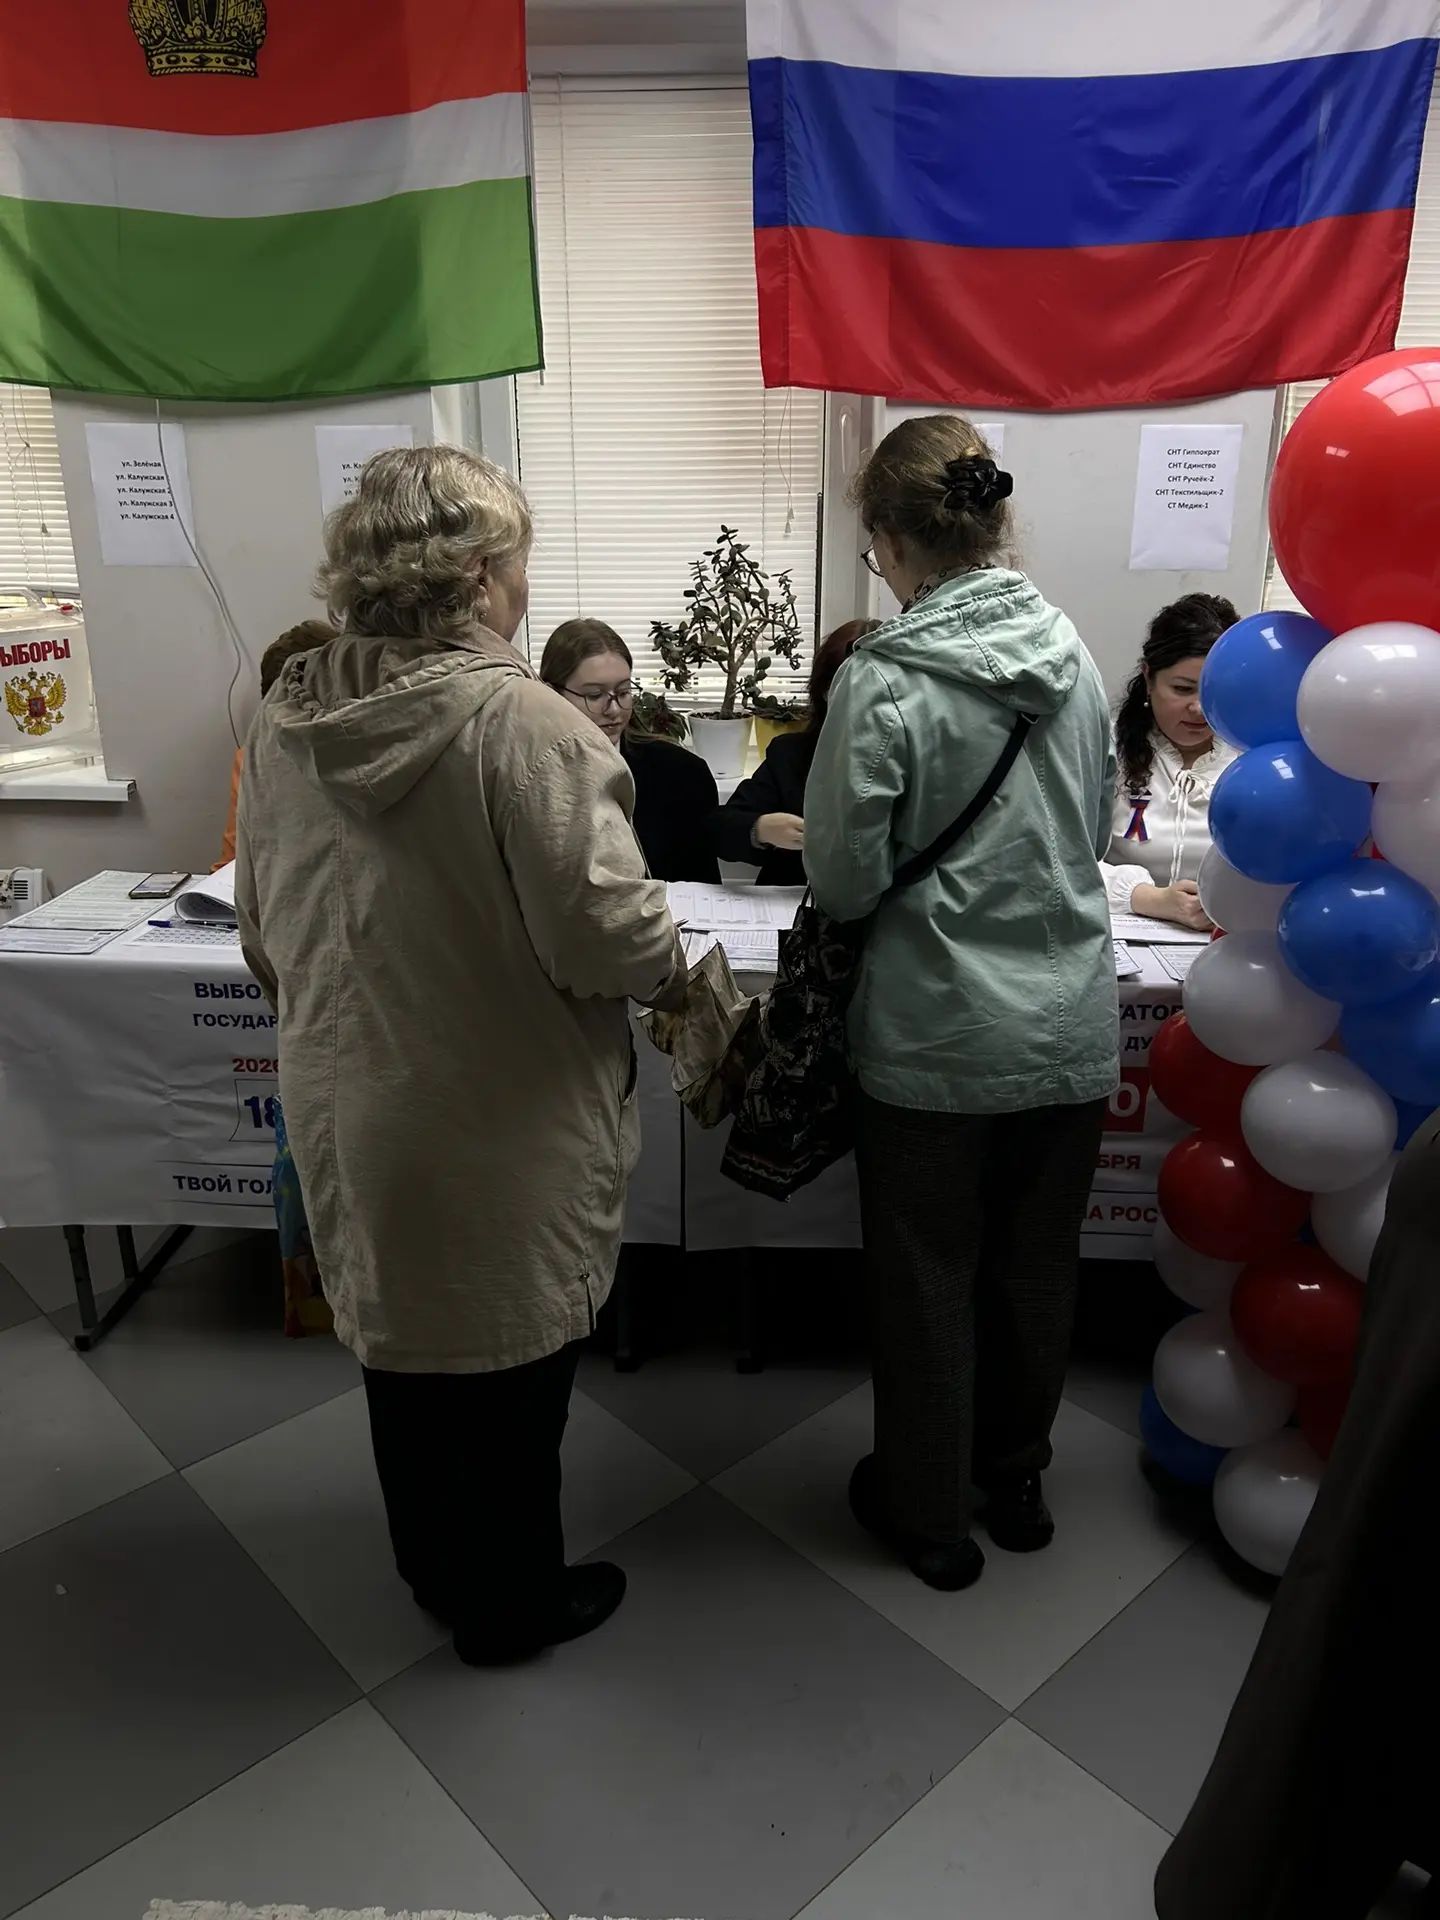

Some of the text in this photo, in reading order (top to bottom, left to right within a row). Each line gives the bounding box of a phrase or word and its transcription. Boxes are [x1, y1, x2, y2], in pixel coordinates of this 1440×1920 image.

[1182, 448, 1220, 457] Гиппократ
[1183, 462, 1217, 470] Единство
[127, 474, 165, 482] Калужская
[129, 487, 166, 495] Калужская
[1171, 488, 1224, 497] Текстильщик-2
[130, 500, 168, 508] Калужская
[1177, 502, 1209, 510] Медик-1
[132, 513, 169, 521] Калужская
[194, 982, 266, 1000] ВЫБО
[172, 1174, 232, 1193] ТВОЙ
